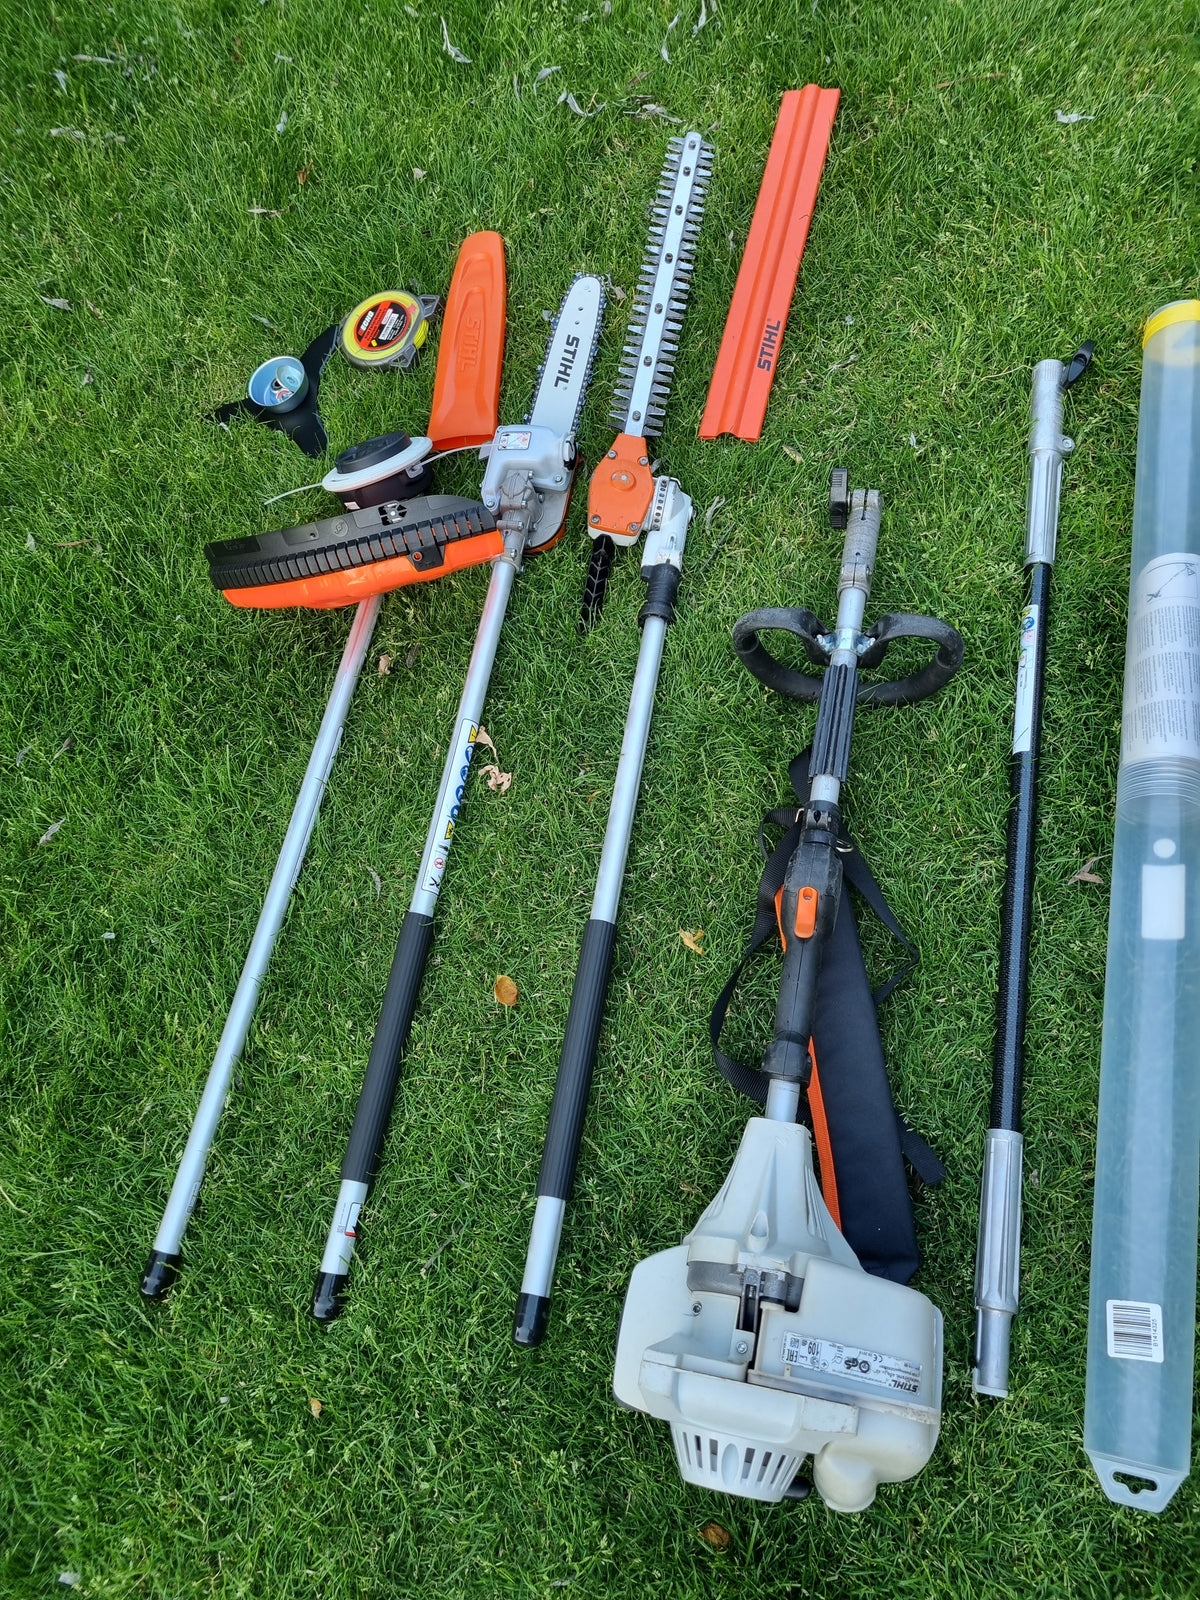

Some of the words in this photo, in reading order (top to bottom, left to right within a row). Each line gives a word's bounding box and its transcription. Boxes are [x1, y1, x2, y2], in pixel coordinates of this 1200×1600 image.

[361, 310, 375, 331] ECHO
[459, 317, 480, 372] STIHL
[554, 334, 580, 388] STIHL
[757, 320, 781, 372] STIHL
[807, 1341, 820, 1356] 109
[891, 1379, 919, 1393] STIHL
